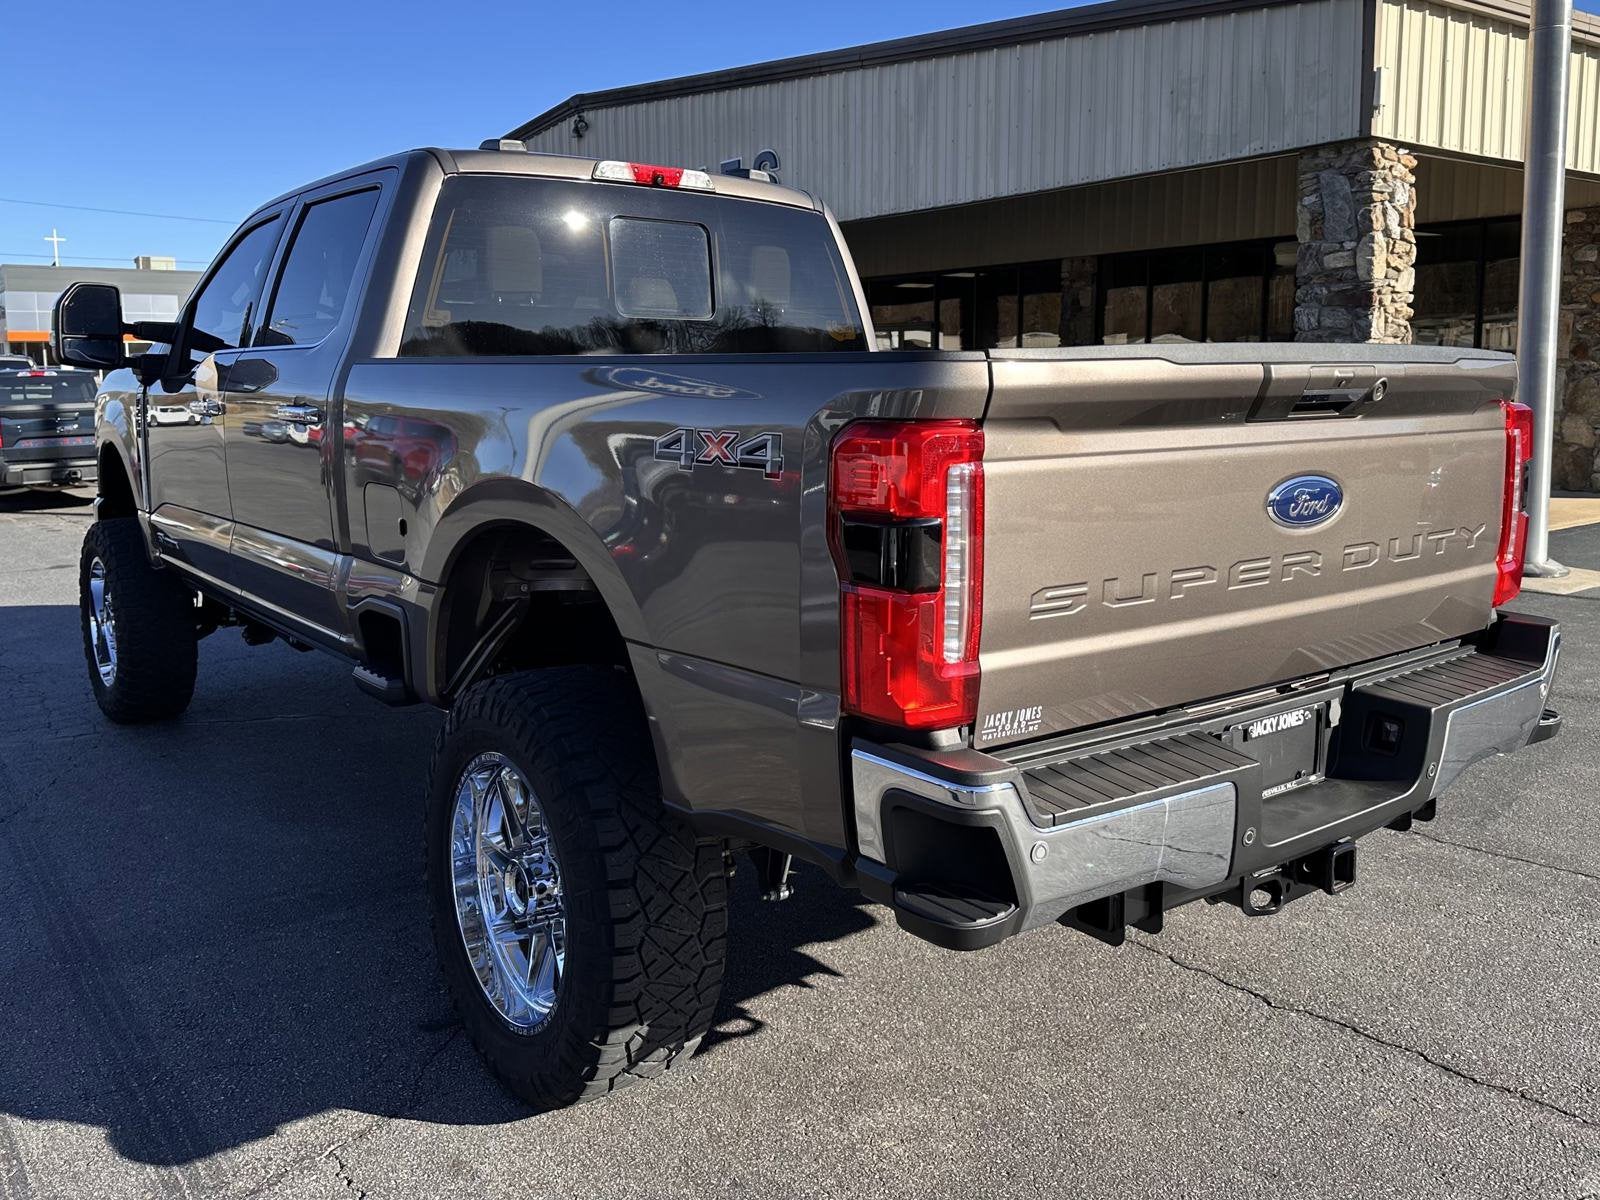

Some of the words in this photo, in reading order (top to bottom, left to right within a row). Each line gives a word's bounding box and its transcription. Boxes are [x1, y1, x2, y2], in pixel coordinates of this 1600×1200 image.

[1288, 487, 1331, 518] Ford
[1029, 549, 1323, 620] SUPER
[1342, 521, 1487, 572] DUTY
[983, 710, 1014, 729] JACKY
[1014, 705, 1043, 722] JONES
[997, 720, 1027, 732] FORD
[1250, 716, 1278, 738] JACKY
[1277, 709, 1305, 731] JONES
